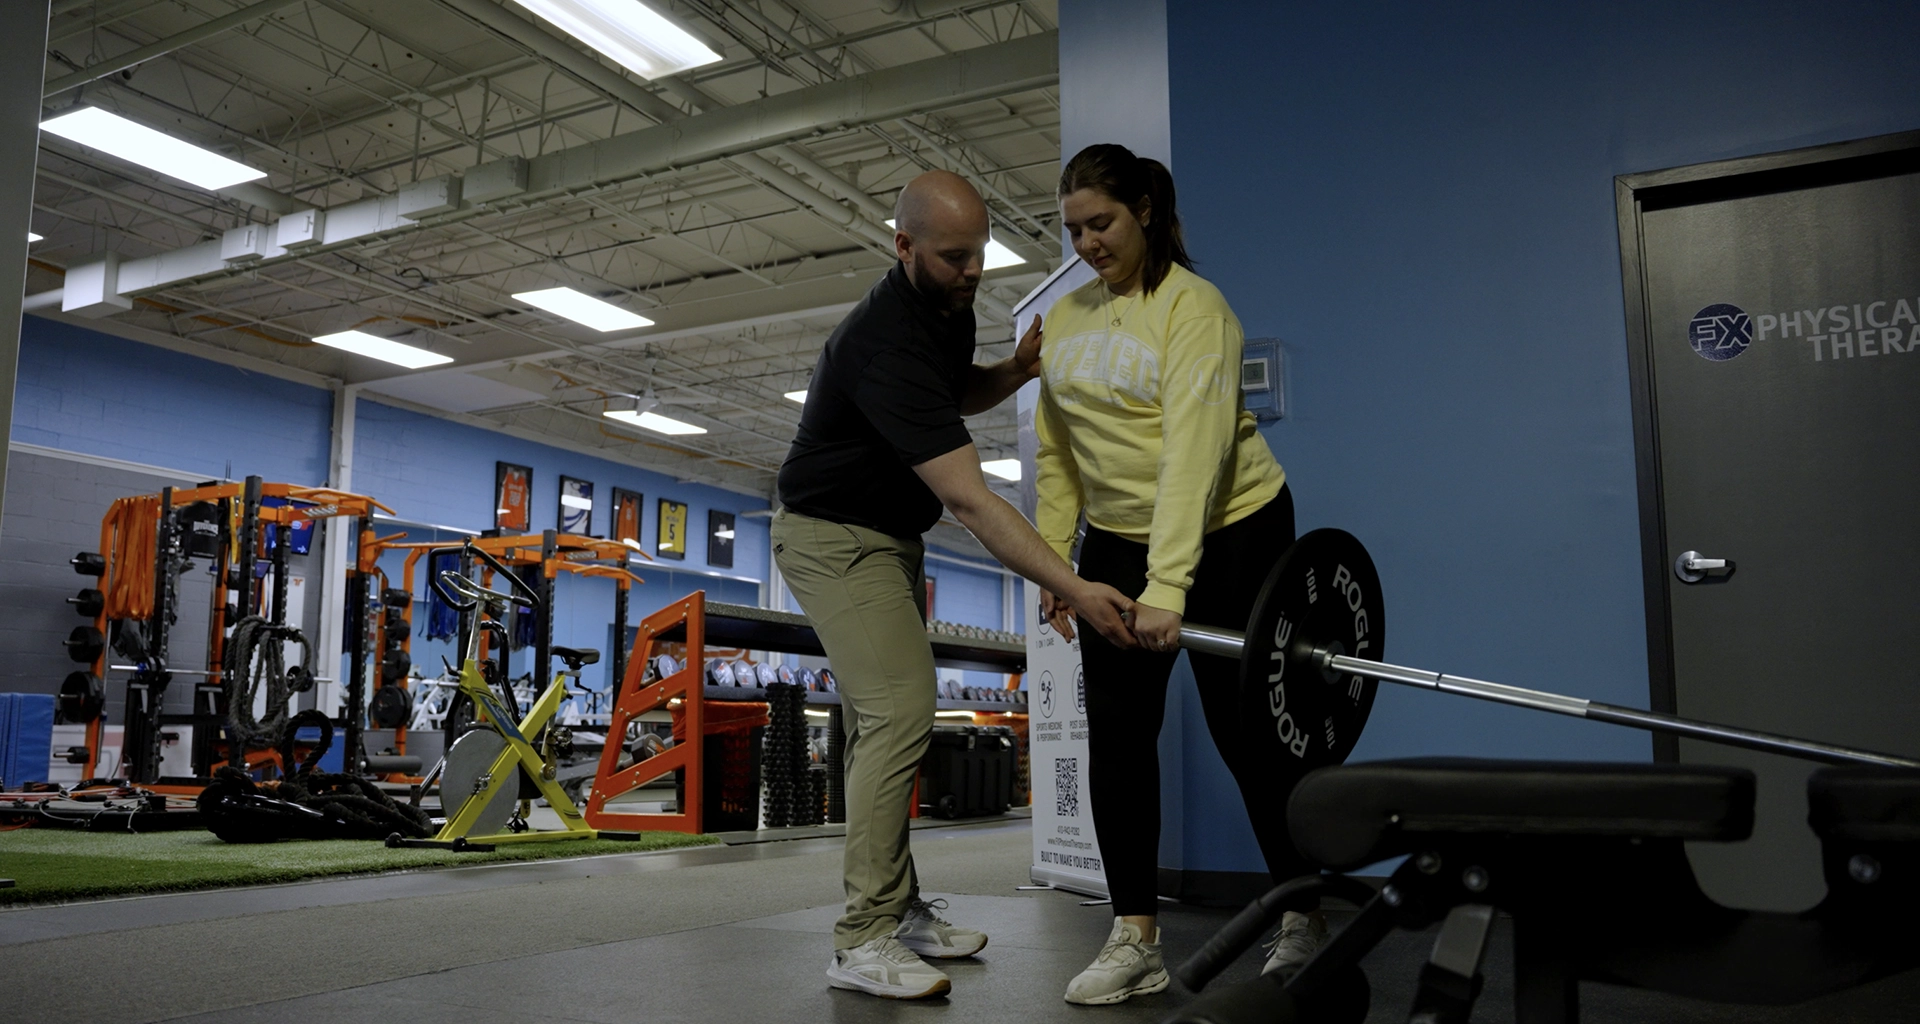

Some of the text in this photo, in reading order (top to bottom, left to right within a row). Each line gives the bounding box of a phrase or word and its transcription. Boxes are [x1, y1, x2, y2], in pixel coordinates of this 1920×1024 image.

[1691, 297, 1920, 353] FX PHYSICA
[1305, 566, 1318, 605] 10LB
[1267, 616, 1310, 759] ROGUE
[1324, 715, 1337, 750] 10LB
[1041, 851, 1101, 871] BUILT TO MAKE YOU BETTER
